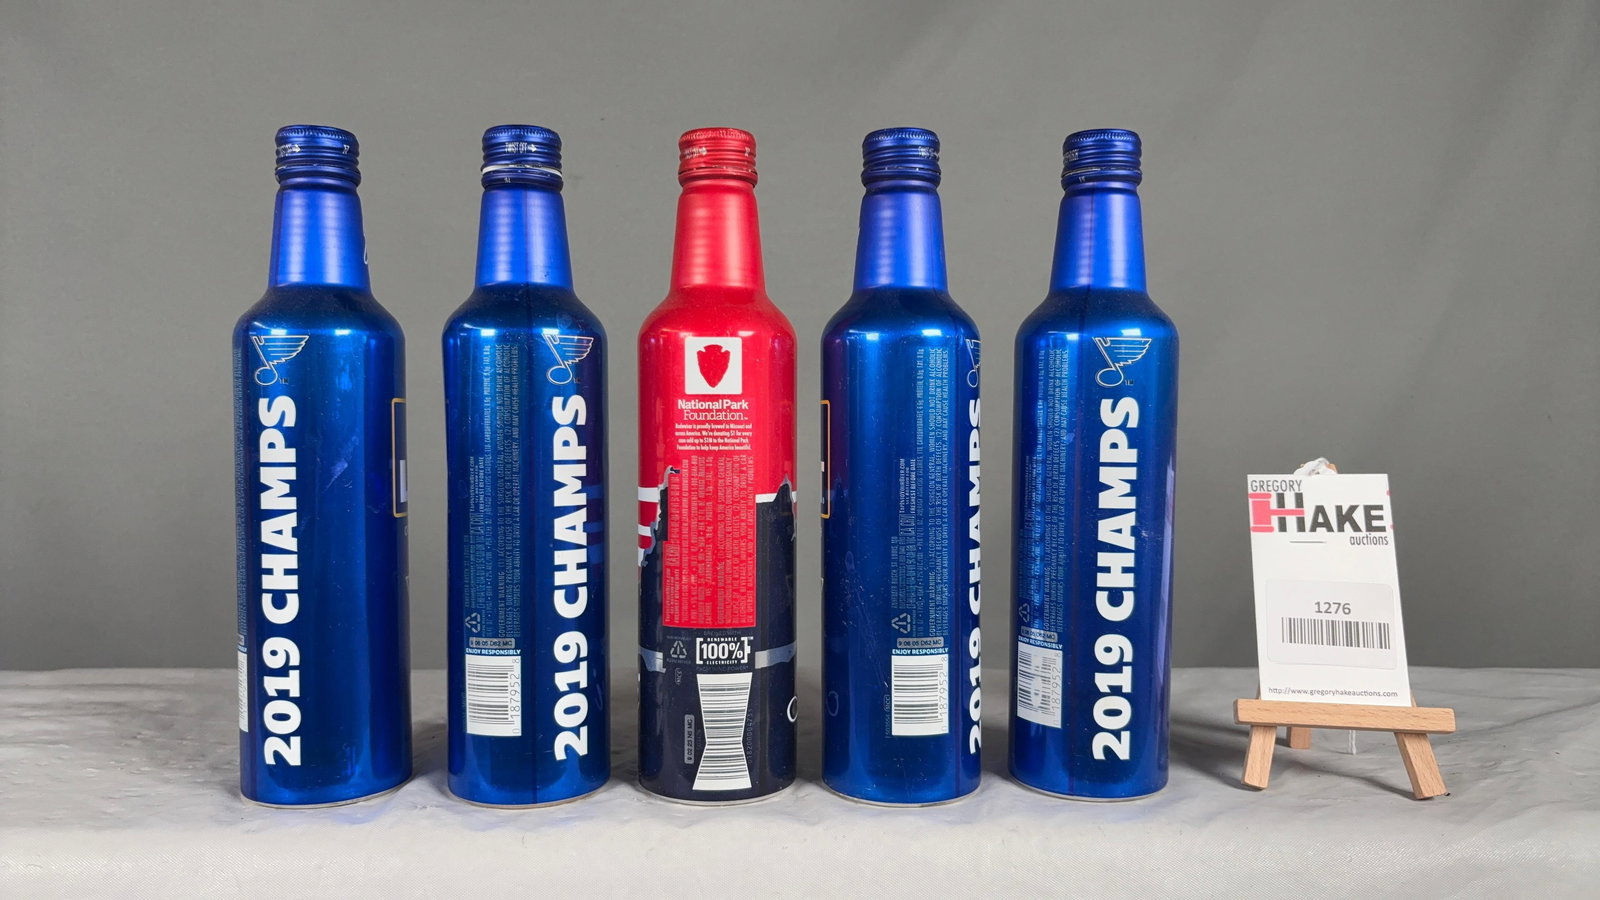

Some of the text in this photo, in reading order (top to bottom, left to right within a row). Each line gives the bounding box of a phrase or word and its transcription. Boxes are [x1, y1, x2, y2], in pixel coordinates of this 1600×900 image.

[678, 399, 748, 409] National Park
[936, 482, 942, 490] OF
[1251, 480, 1302, 492] GREGORY
[1276, 492, 1386, 532] HAKE
[1349, 533, 1388, 546] auctions
[259, 395, 302, 766] 2019 CHAMPS
[552, 394, 588, 760] 2019 CHAMPS
[969, 398, 982, 754] 2019 CHAMPS
[1093, 396, 1138, 760] 2019 CHAMPS
[1314, 601, 1351, 615] 1276
[701, 642, 743, 659] 100%
[1030, 639, 1063, 649] RESPONSIBLY
[510, 673, 520, 719] 187952
[939, 672, 947, 716] 187952
[1052, 665, 1060, 711] 187952
[1268, 687, 1398, 697] http://www.gregoryhakeauctions.com
